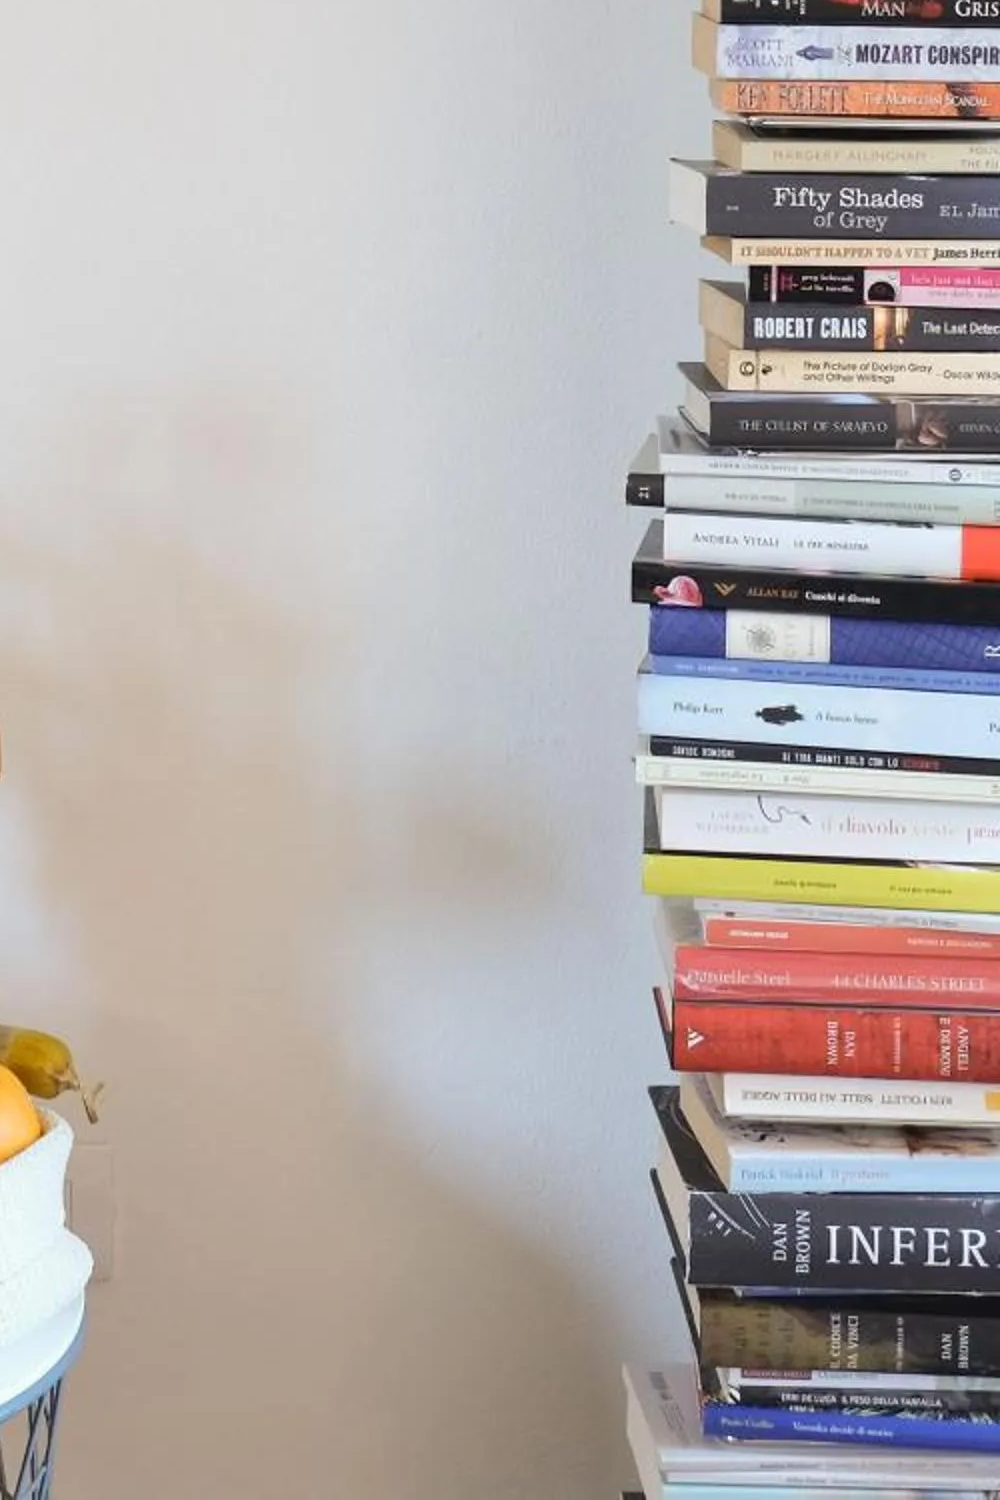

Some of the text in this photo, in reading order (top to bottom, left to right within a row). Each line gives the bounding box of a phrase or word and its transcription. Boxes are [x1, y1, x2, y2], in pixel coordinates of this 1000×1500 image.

[862, 1, 905, 16] MAN
[855, 44, 923, 63] MOZART
[737, 84, 849, 112] KEN FOLLETT
[773, 151, 927, 162] MARGERY ALLINGHAM
[773, 188, 924, 211] Fifty Shades
[940, 205, 962, 217] EL
[813, 211, 888, 232] of Grey
[741, 247, 752, 257] IT
[877, 248, 893, 258] TO
[933, 248, 968, 260] James
[754, 317, 868, 339] ROBERT CRAIS
[923, 322, 968, 335] The Last
[803, 361, 932, 376] The Picture of Dorian Gray
[819, 373, 848, 382] Other
[850, 373, 895, 384] Writings
[739, 420, 888, 434] THE CELLIST OF SARAJEVO
[692, 533, 740, 546] ANDREA
[743, 534, 780, 547] VITALI
[747, 588, 779, 598] ALLAN
[673, 703, 701, 714] Philip
[838, 816, 906, 836] diavolo
[755, 971, 792, 985] Steel
[854, 972, 926, 990] CHARLES
[930, 976, 985, 992] STREET
[826, 1021, 839, 1066] BROWN
[957, 1026, 969, 1071] ANGELI
[772, 1222, 787, 1262] DAN
[795, 1209, 811, 1274] BROWN
[826, 1225, 1000, 1267] INFER
[830, 1312, 841, 1369] IL CODICE
[847, 1315, 859, 1369] DA VINCI
[941, 1333, 952, 1360] DAN
[958, 1324, 969, 1369] BROWN
